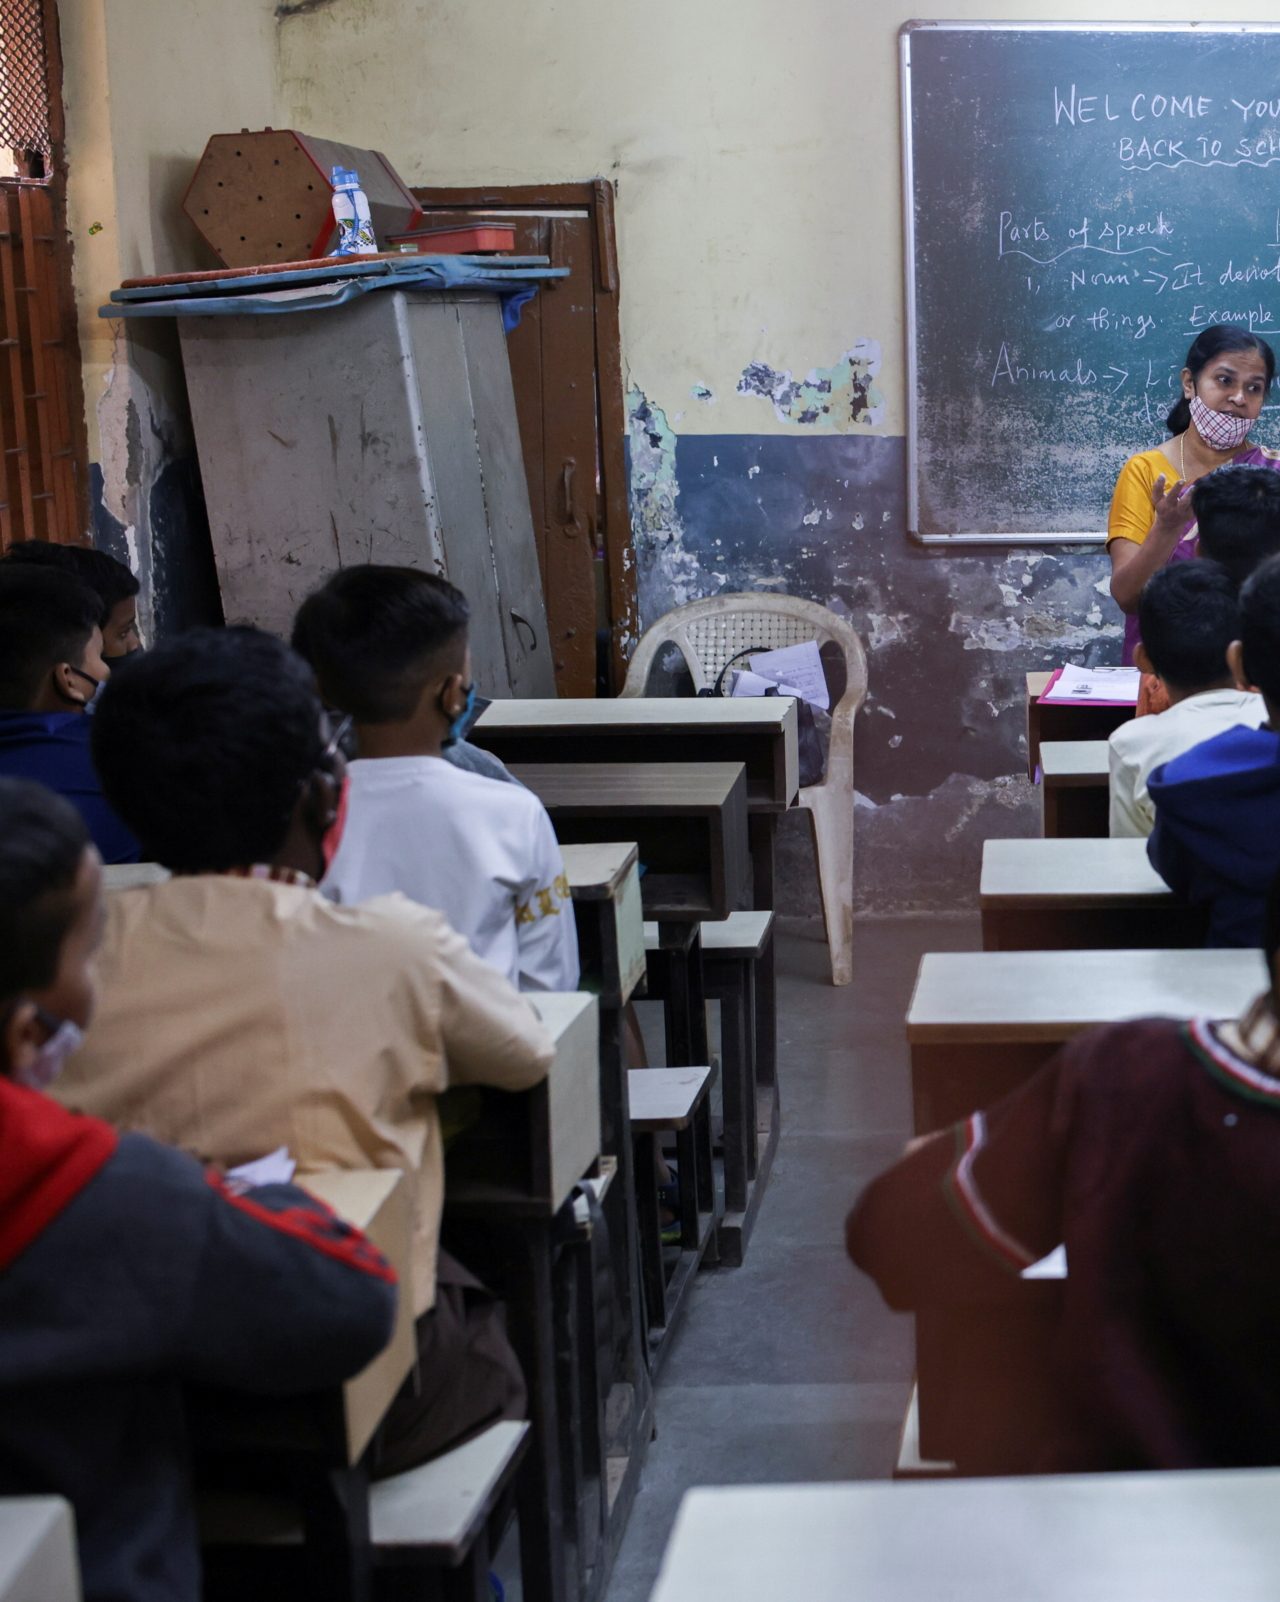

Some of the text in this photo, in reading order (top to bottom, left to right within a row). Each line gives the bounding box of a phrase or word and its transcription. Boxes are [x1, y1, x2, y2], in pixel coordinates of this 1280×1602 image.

[1054, 83, 1213, 126] WELCOME
[1119, 136, 1188, 162] BACK
[1196, 136, 1222, 158] TO
[998, 211, 1050, 257] Parts
[1068, 217, 1089, 248] of
[1070, 269, 1131, 291] Noun
[1172, 262, 1206, 291] It
[991, 341, 1098, 388] Animals
